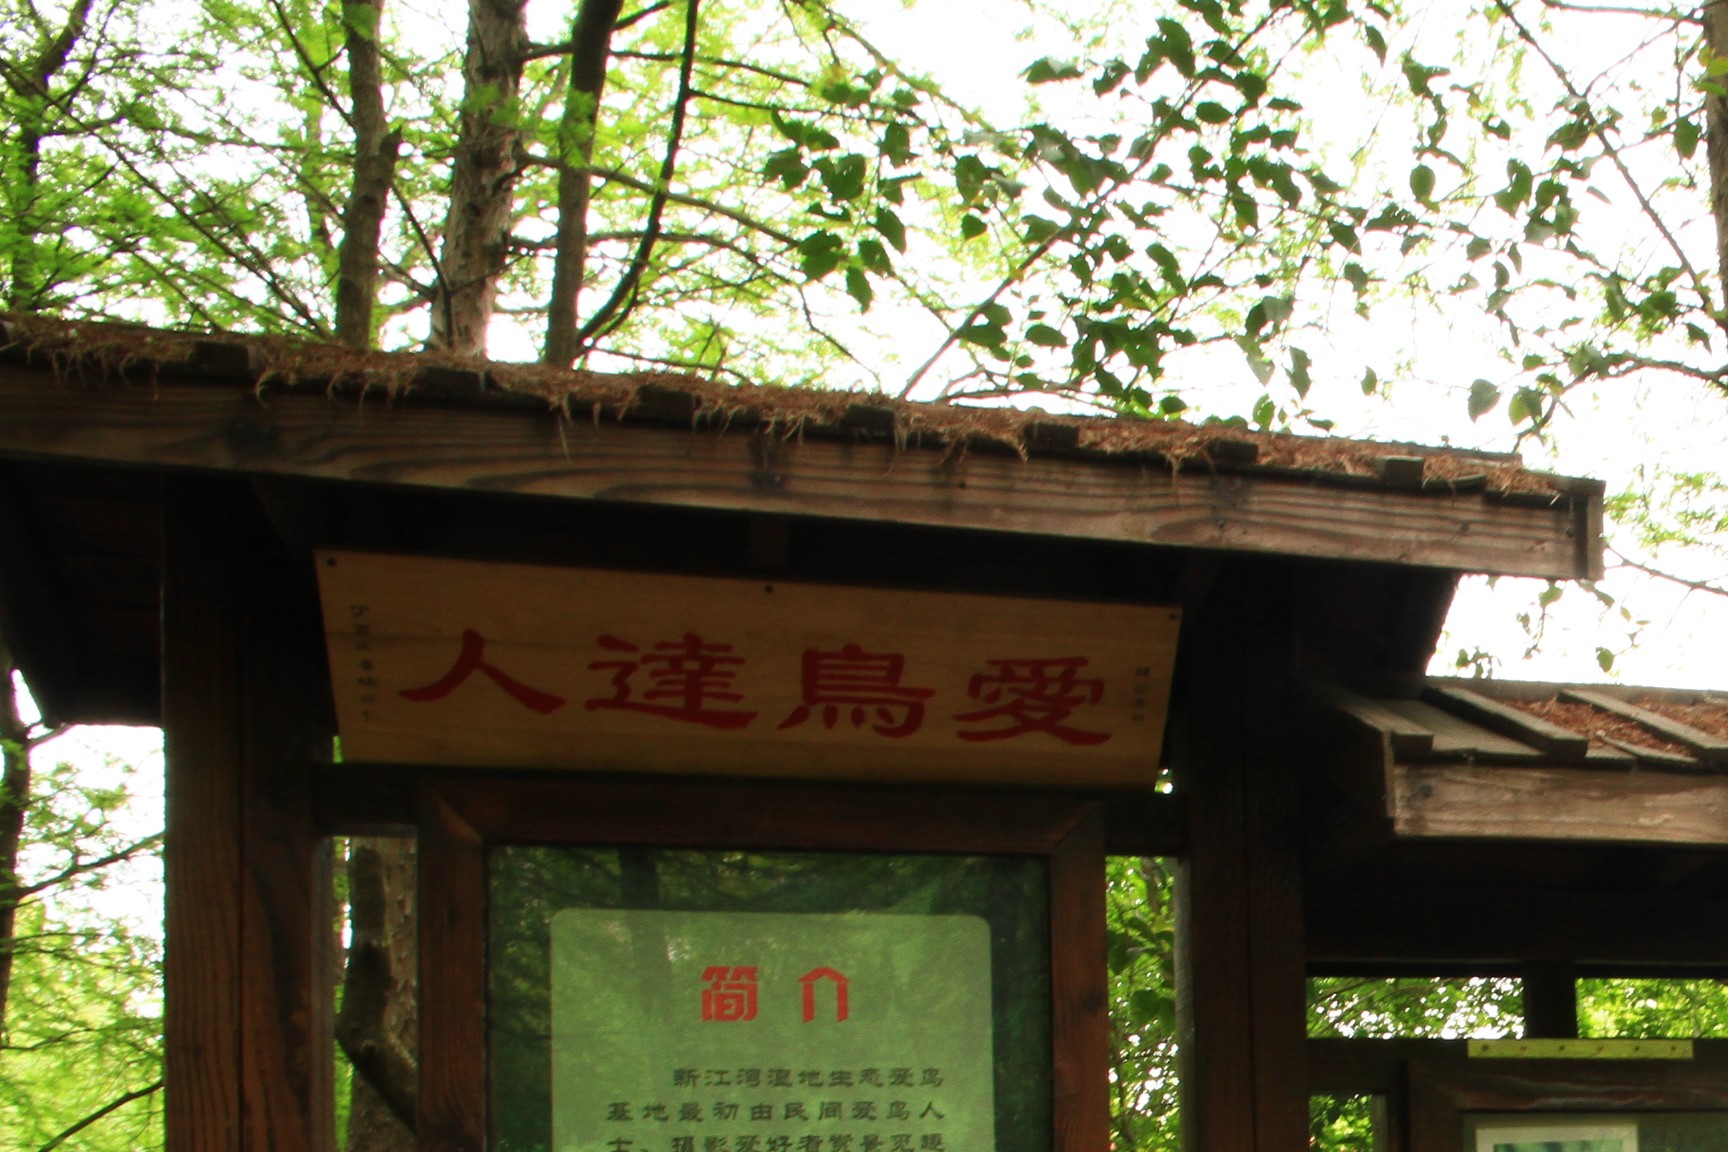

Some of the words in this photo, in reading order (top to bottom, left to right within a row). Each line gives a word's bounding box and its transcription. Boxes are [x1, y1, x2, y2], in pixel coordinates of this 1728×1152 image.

[701, 966, 852, 1023] 简介
[673, 1067, 944, 1089] 新江湾湿地生态爱鸟
[606, 1100, 946, 1123] 基地最初由民间爱鸟人
